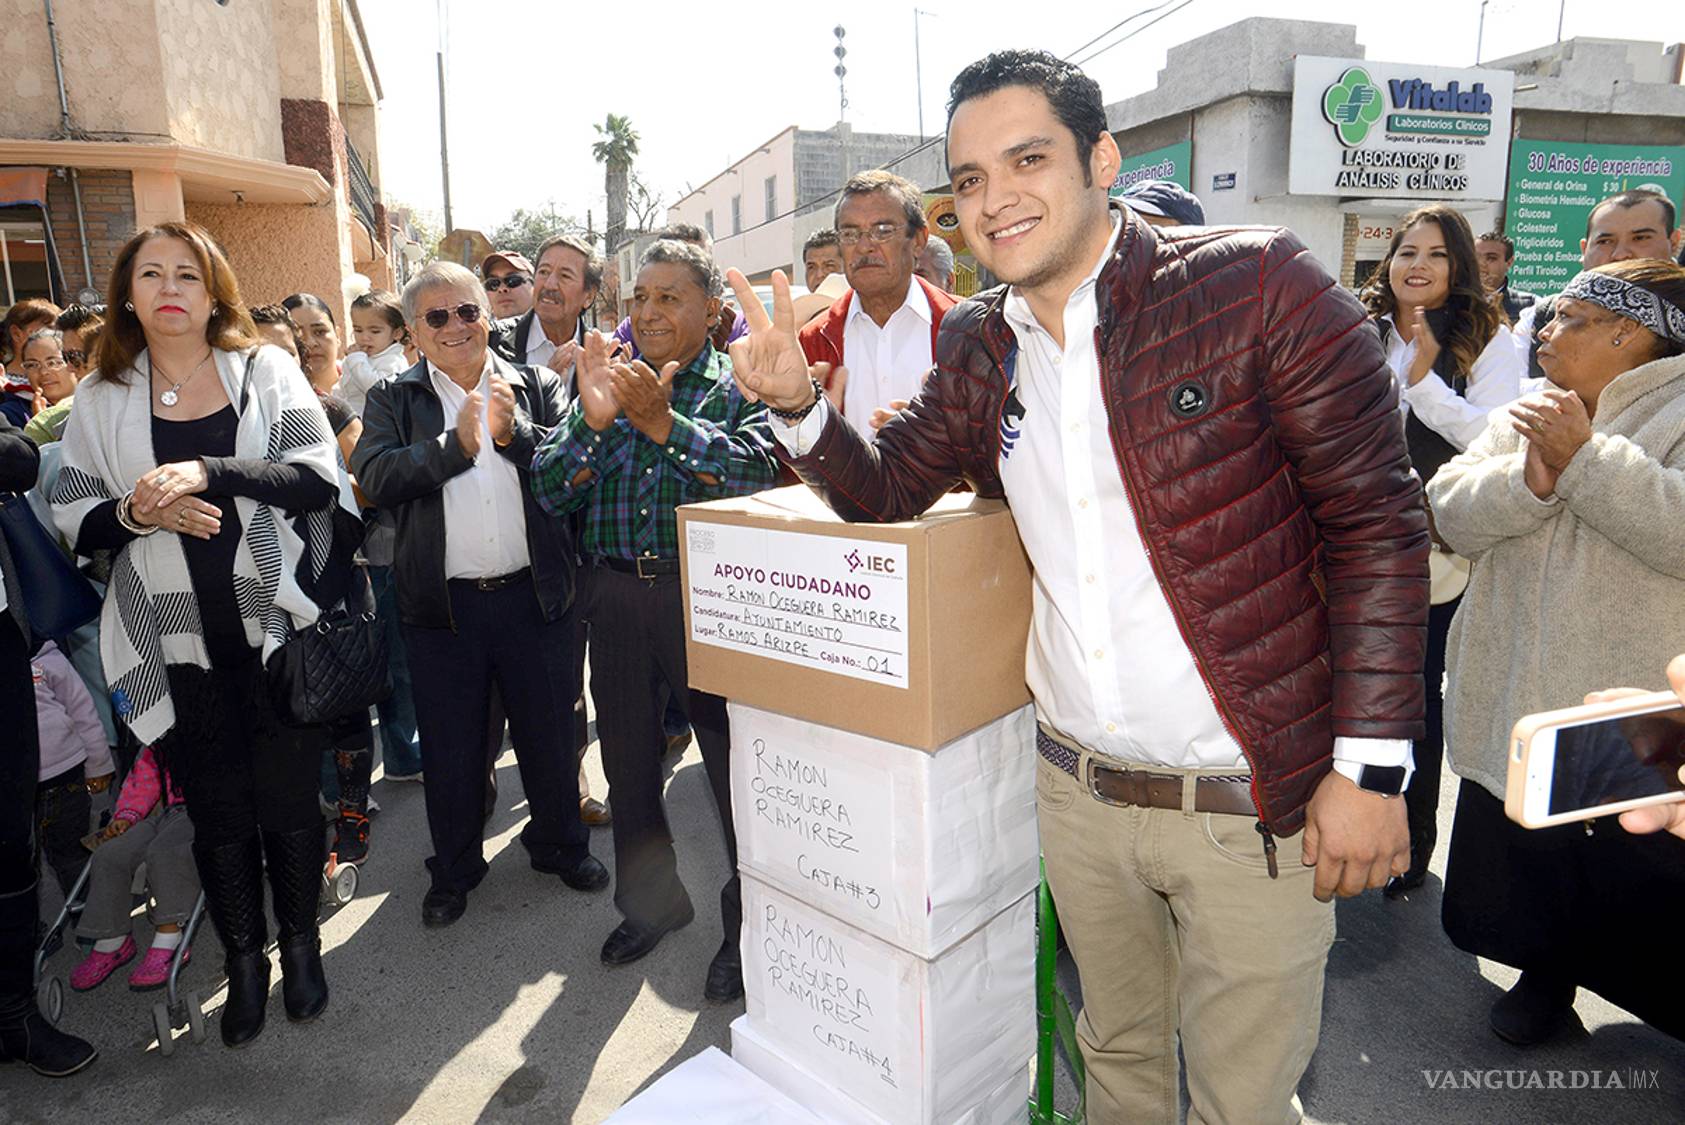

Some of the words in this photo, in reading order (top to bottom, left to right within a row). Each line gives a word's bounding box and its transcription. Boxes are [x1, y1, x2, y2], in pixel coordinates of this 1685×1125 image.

[1388, 78, 1492, 114] Vitalab
[1395, 117, 1453, 130] Laboratorios
[1385, 134, 1415, 144] Seguridad
[1113, 159, 1175, 188] experiencia
[1342, 150, 1441, 169] LABORATORIO
[1445, 154, 1466, 170] DE
[1528, 152, 1544, 172] 30
[1548, 153, 1579, 174] Años
[1582, 154, 1599, 173] de
[1601, 156, 1672, 178] experiencia
[1336, 167, 1401, 188] ANÁLISIS
[1406, 170, 1469, 190] CLÍNICOS
[1521, 179, 1552, 190] General
[1553, 180, 1564, 191] de
[1566, 181, 1587, 191] Orina
[1517, 222, 1557, 233] Colesterol
[1518, 208, 1551, 219] Glucosa
[1513, 265, 1534, 276] Perfil
[1535, 265, 1568, 276] Tiroideo
[1514, 251, 1542, 262] Prueba
[1543, 252, 1554, 262] de
[867, 555, 895, 573] IEC
[714, 563, 766, 584] APOYO
[770, 571, 871, 601] CIUDADANO
[693, 586, 725, 600] Nombre:
[769, 591, 824, 615] OCEGUERA
[832, 602, 901, 631] RAMIREZ
[693, 605, 741, 622] Candidatura:
[742, 608, 843, 642] AYUNTAMIENTO
[694, 624, 717, 638] Lugar:
[717, 623, 758, 645] RAMOS
[764, 632, 809, 657] ARIZPE
[820, 651, 839, 665] Caja
[867, 655, 895, 675] 01
[753, 738, 827, 788] RAMON
[751, 777, 851, 826] OCEGUERA
[755, 798, 859, 853] RAMIREZ
[766, 904, 846, 968] RAMON
[764, 937, 873, 1016] OCEGUERA
[768, 966, 870, 1032] RAMIREZ
